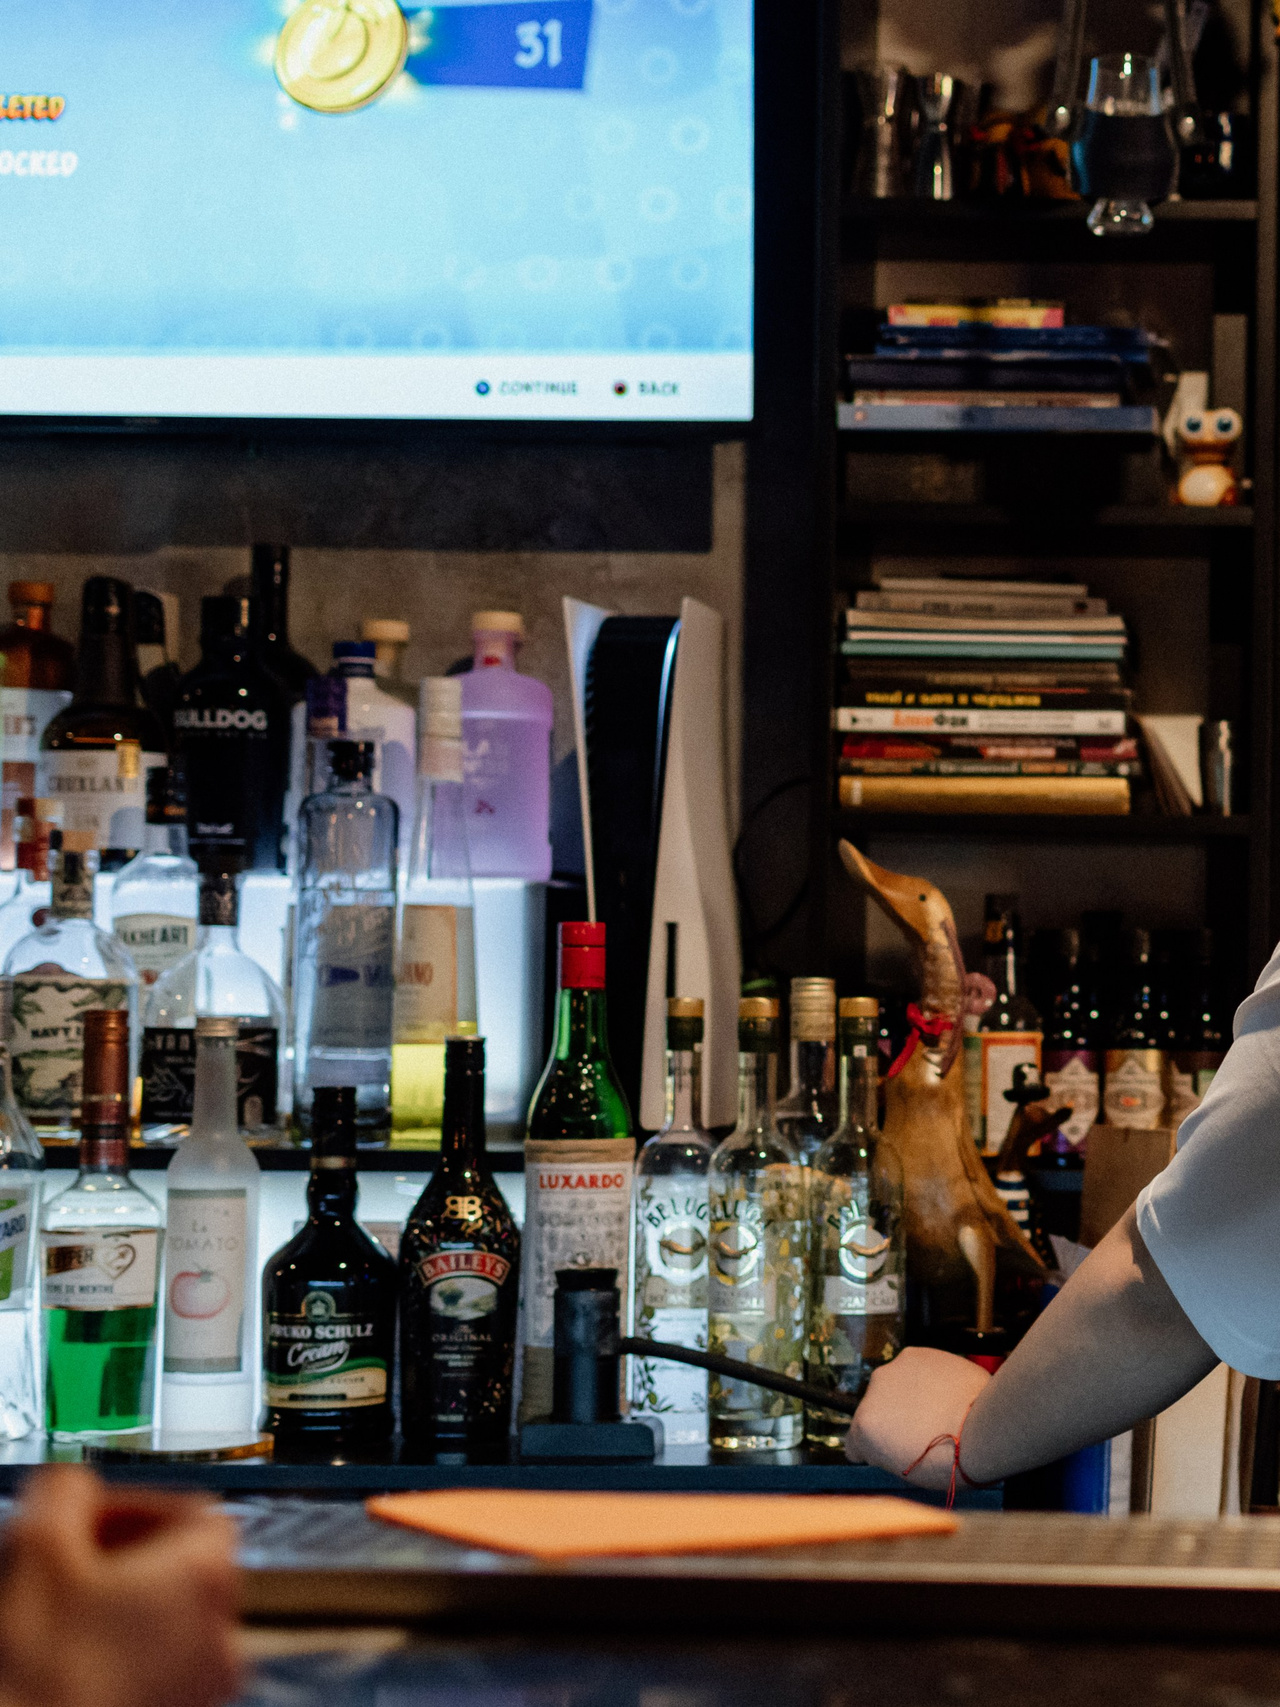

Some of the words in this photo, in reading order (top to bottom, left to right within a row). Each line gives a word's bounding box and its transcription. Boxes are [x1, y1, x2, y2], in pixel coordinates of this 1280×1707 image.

[514, 19, 563, 68] 31
[499, 381, 578, 396] CONTINUE
[638, 381, 680, 396] BACK
[174, 708, 268, 731] BULLDOG
[31, 1026, 71, 1040] NAVY
[538, 1173, 625, 1190] LUXARDO
[646, 1197, 708, 1229] BELUG
[421, 1252, 507, 1281] BAILEYS
[314, 1323, 374, 1340] SCHULZ
[432, 1333, 493, 1342] ORIGINAL
